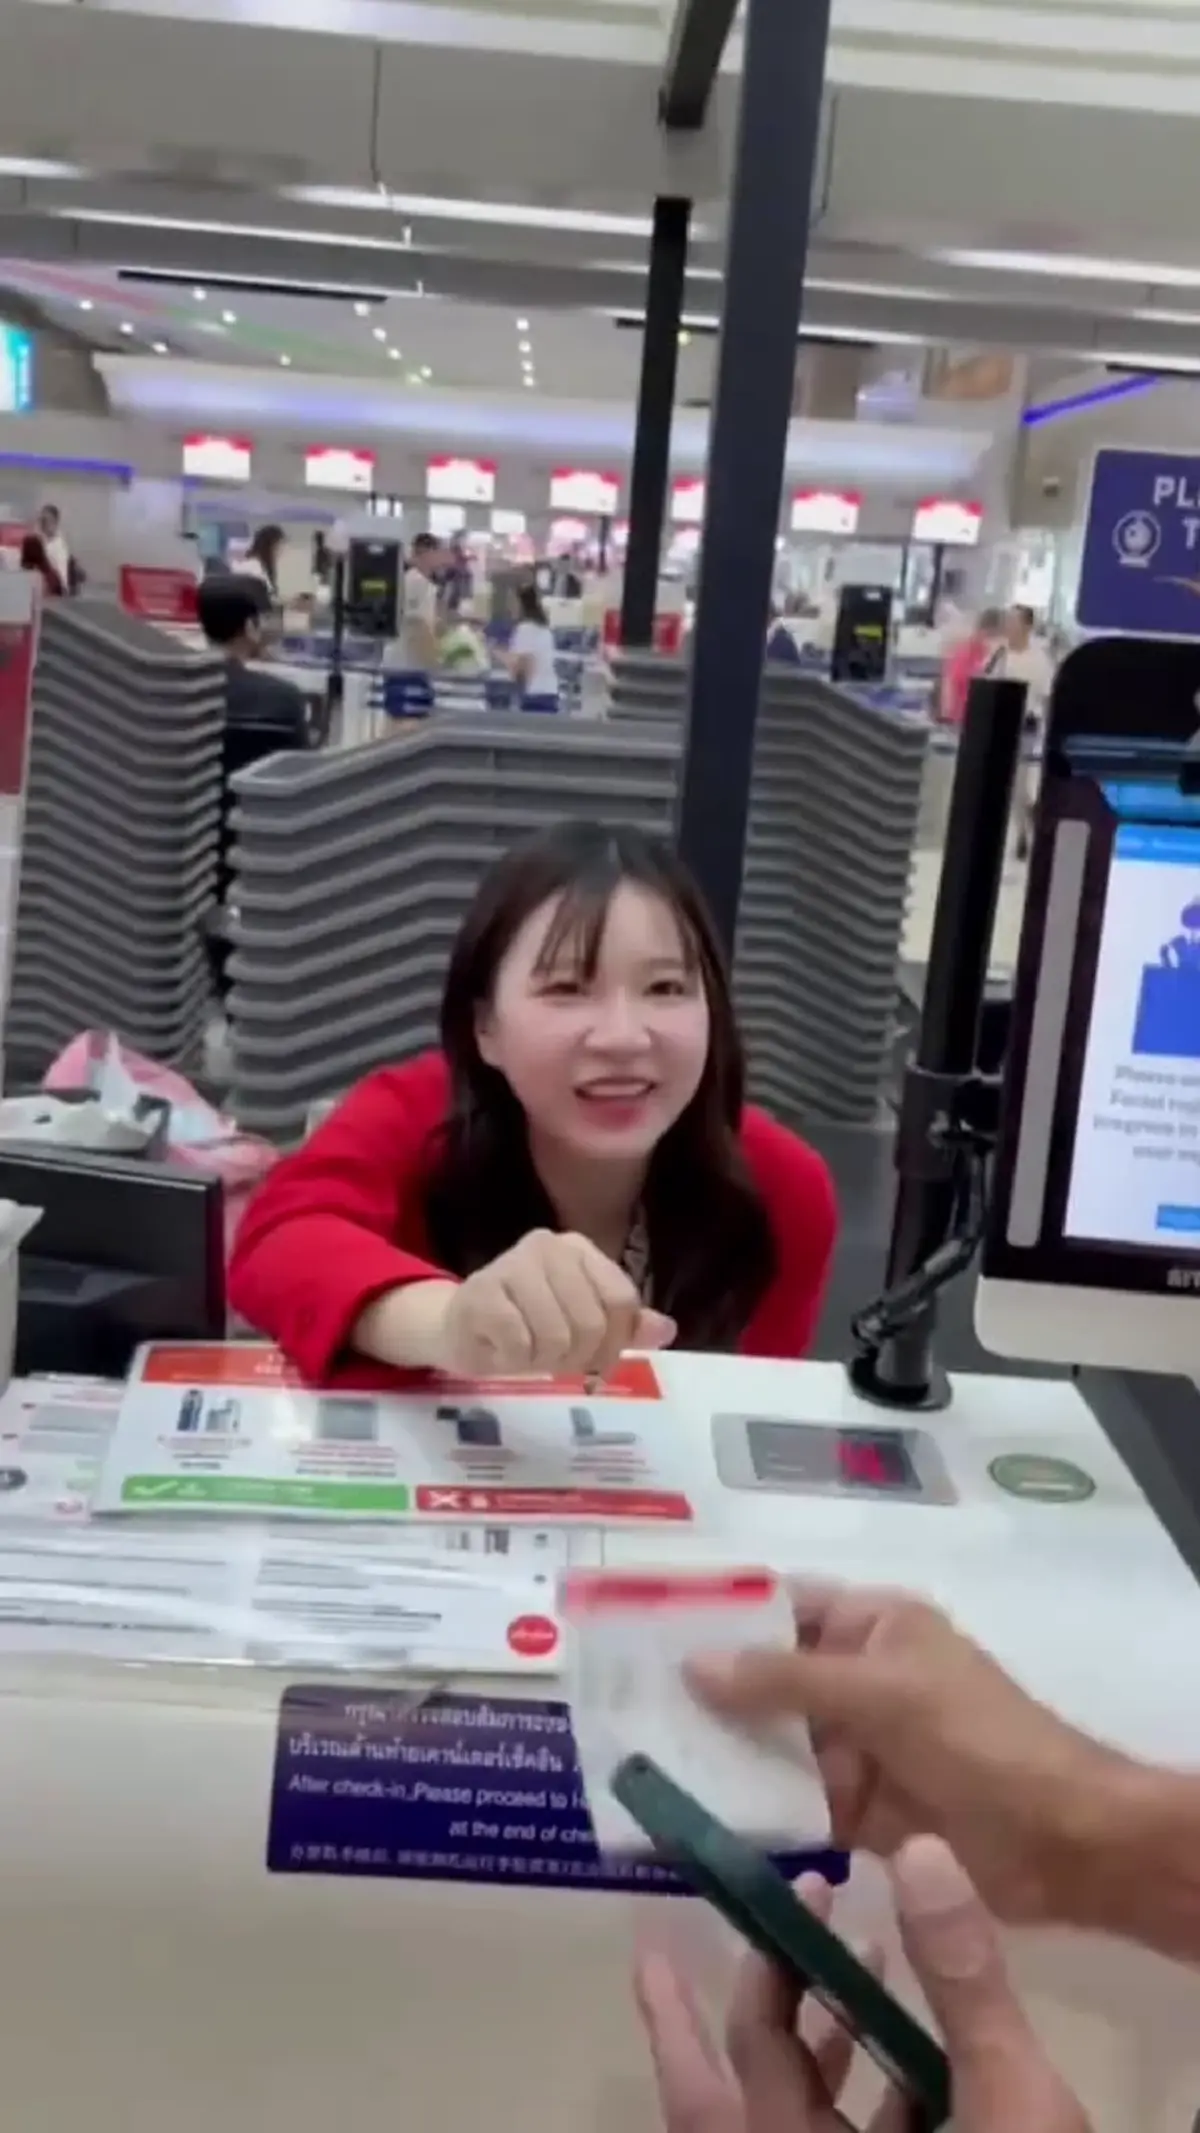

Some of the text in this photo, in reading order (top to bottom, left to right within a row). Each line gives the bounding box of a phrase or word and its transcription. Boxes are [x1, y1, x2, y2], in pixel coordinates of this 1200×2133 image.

[1153, 475, 1200, 508] PL
[288, 1774, 330, 1793] After
[476, 1788, 546, 1808] proceed
[550, 1791, 568, 1809] to
[448, 1821, 467, 1837] at
[472, 1821, 498, 1838] the
[503, 1823, 535, 1840] end
[540, 1825, 558, 1842] of
